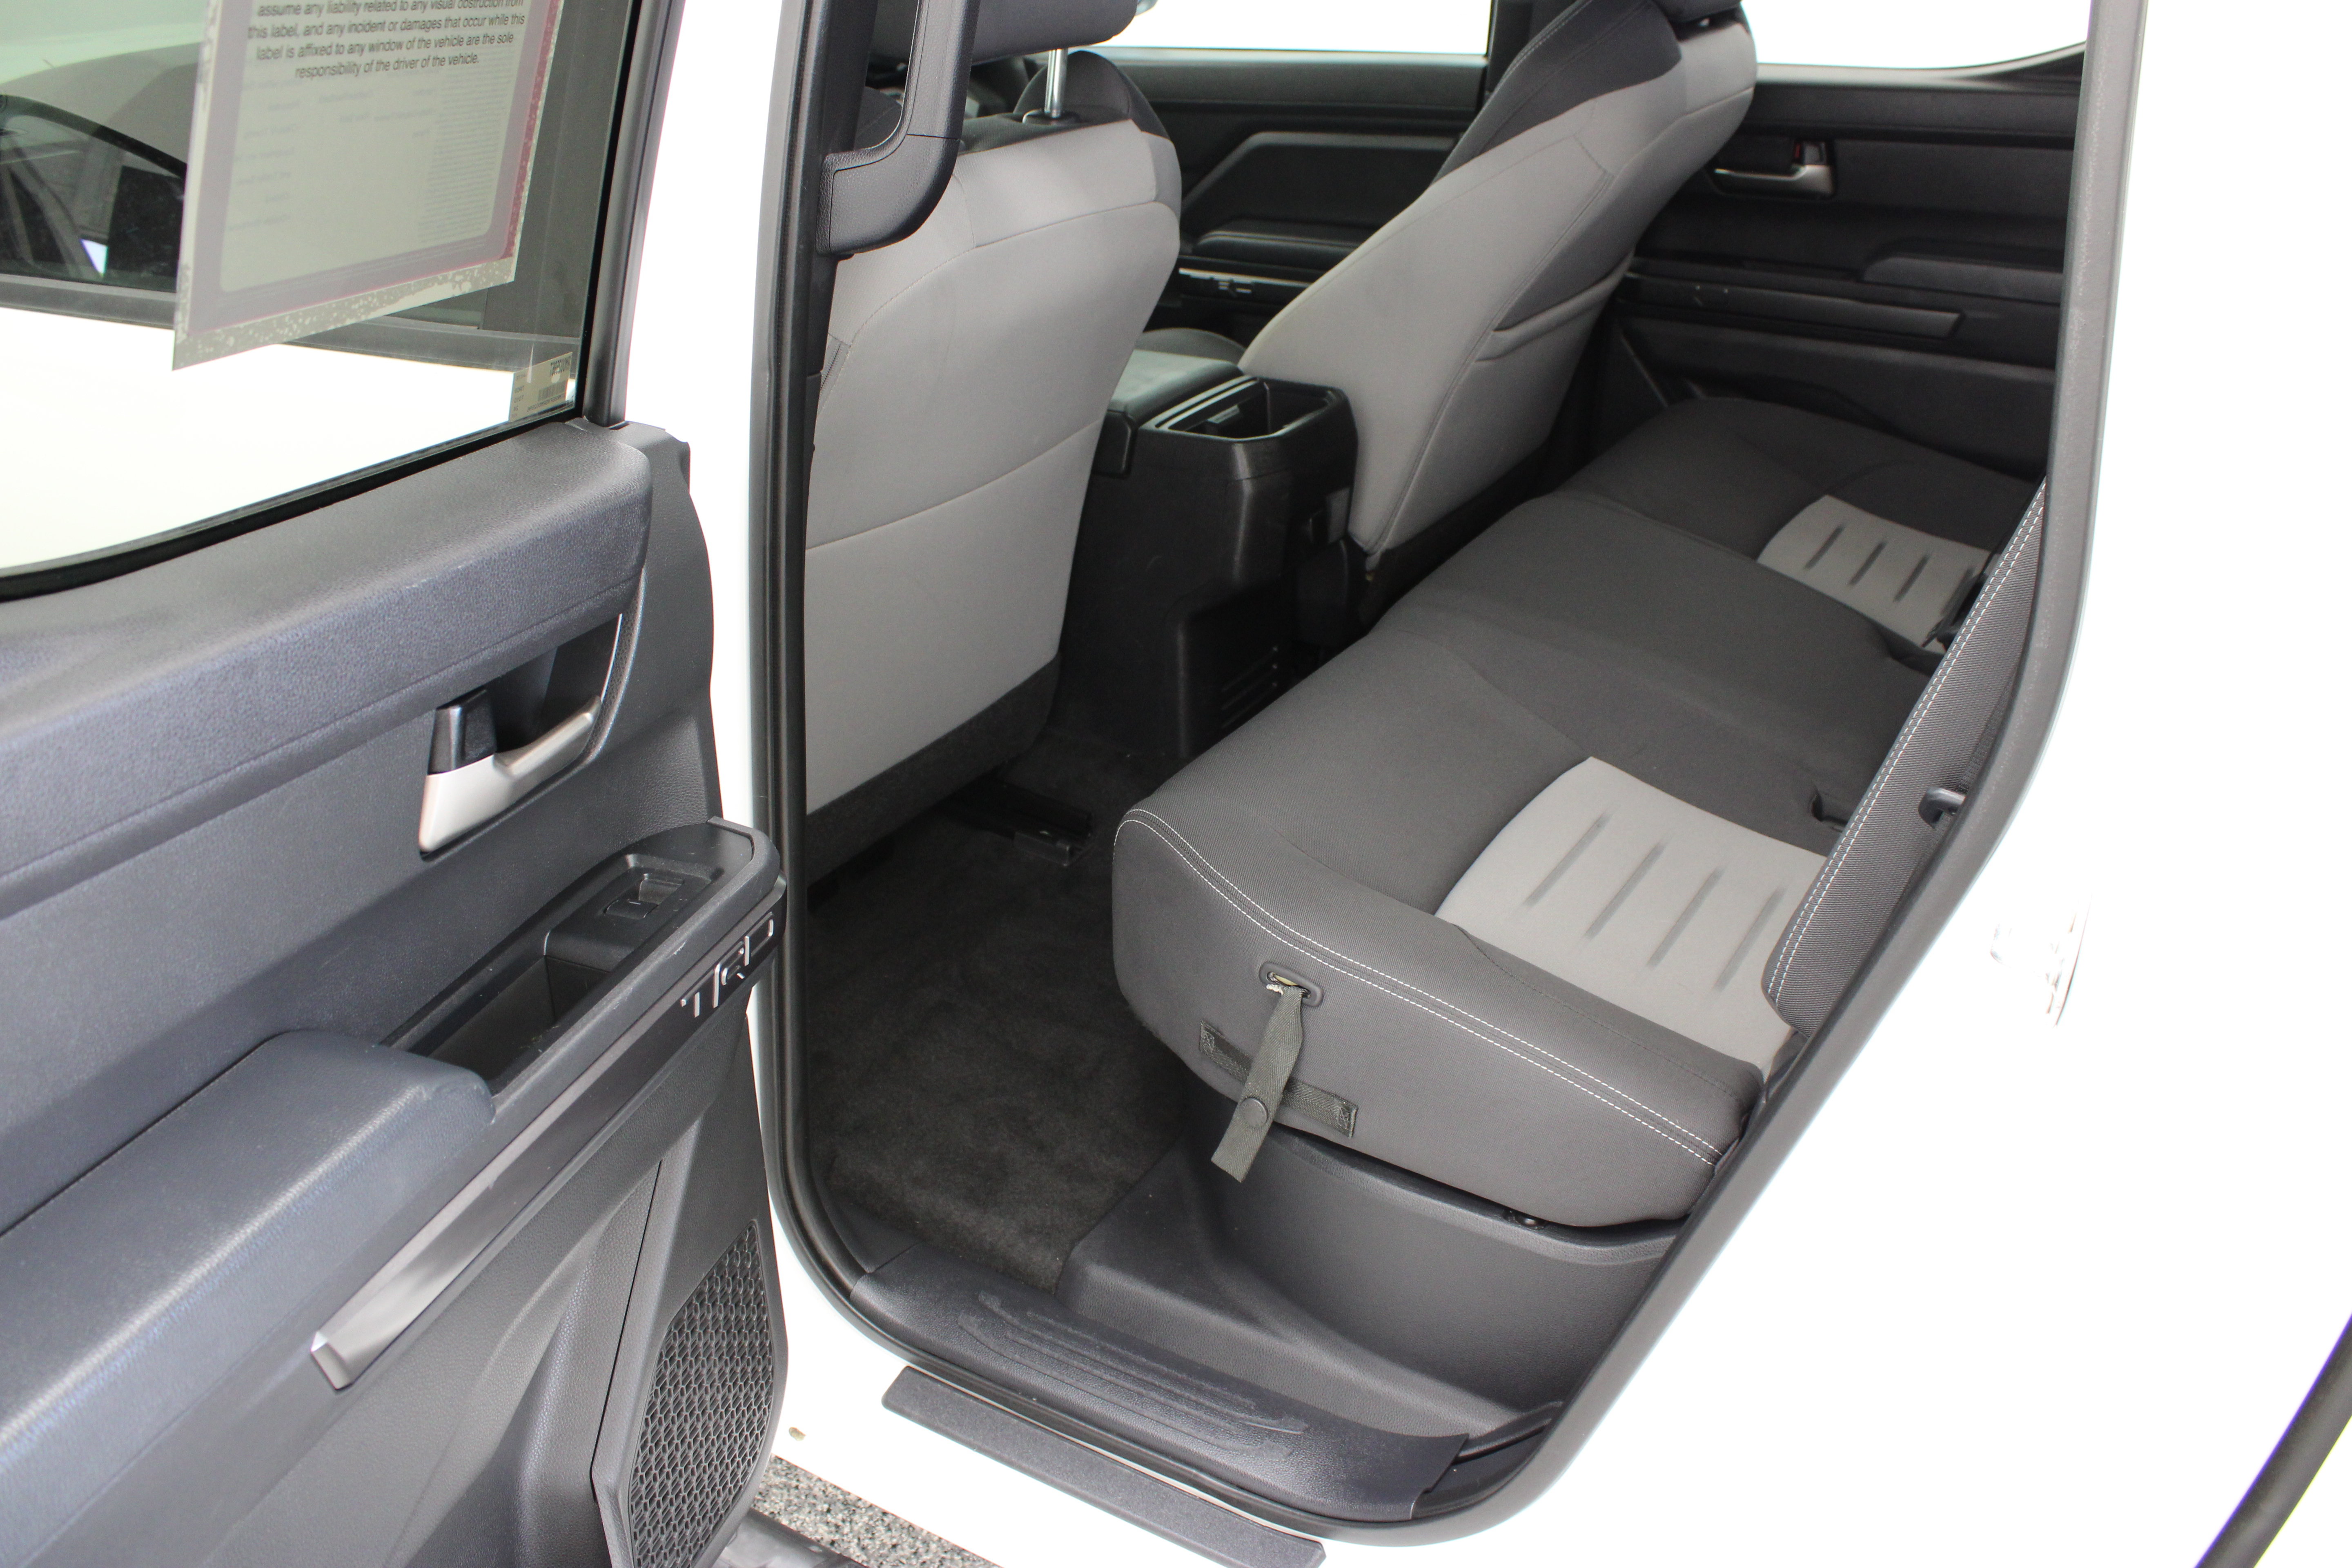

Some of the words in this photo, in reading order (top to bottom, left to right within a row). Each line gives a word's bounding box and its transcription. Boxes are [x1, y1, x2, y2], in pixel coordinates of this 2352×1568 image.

[258, 4, 301, 16] assume
[304, 4, 324, 18] any
[327, 0, 361, 16] liability
[363, 0, 397, 12] related
[399, 0, 408, 11] to
[411, 1, 428, 13] any
[431, 0, 455, 9] visual
[458, 0, 503, 9] obstruction
[247, 24, 268, 38] this
[270, 22, 300, 38] label,
[303, 22, 324, 36] and
[326, 24, 345, 38] any
[347, 20, 386, 33] incident
[388, 22, 399, 31] or
[400, 18, 441, 32] damages
[444, 16, 461, 28] that
[462, 17, 486, 27] occur
[488, 13, 509, 26] while
[510, 13, 525, 24] this
[256, 44, 283, 60] label
[287, 44, 294, 58] is
[298, 42, 333, 58] affixed
[335, 42, 345, 54] to
[347, 43, 366, 56] any
[368, 39, 403, 52] window
[405, 37, 416, 50] of
[417, 36, 431, 49] the
[434, 35, 464, 48] vehicle
[466, 36, 480, 46] are
[482, 33, 495, 44] the
[497, 32, 514, 44] sole
[295, 61, 362, 81] responsibility
[364, 59, 374, 73] of
[376, 59, 390, 71] the
[392, 57, 420, 70] driver
[421, 55, 431, 68] of
[432, 54, 446, 67] the
[448, 52, 479, 65] vehicle.
[680, 911, 775, 1018] TRD
